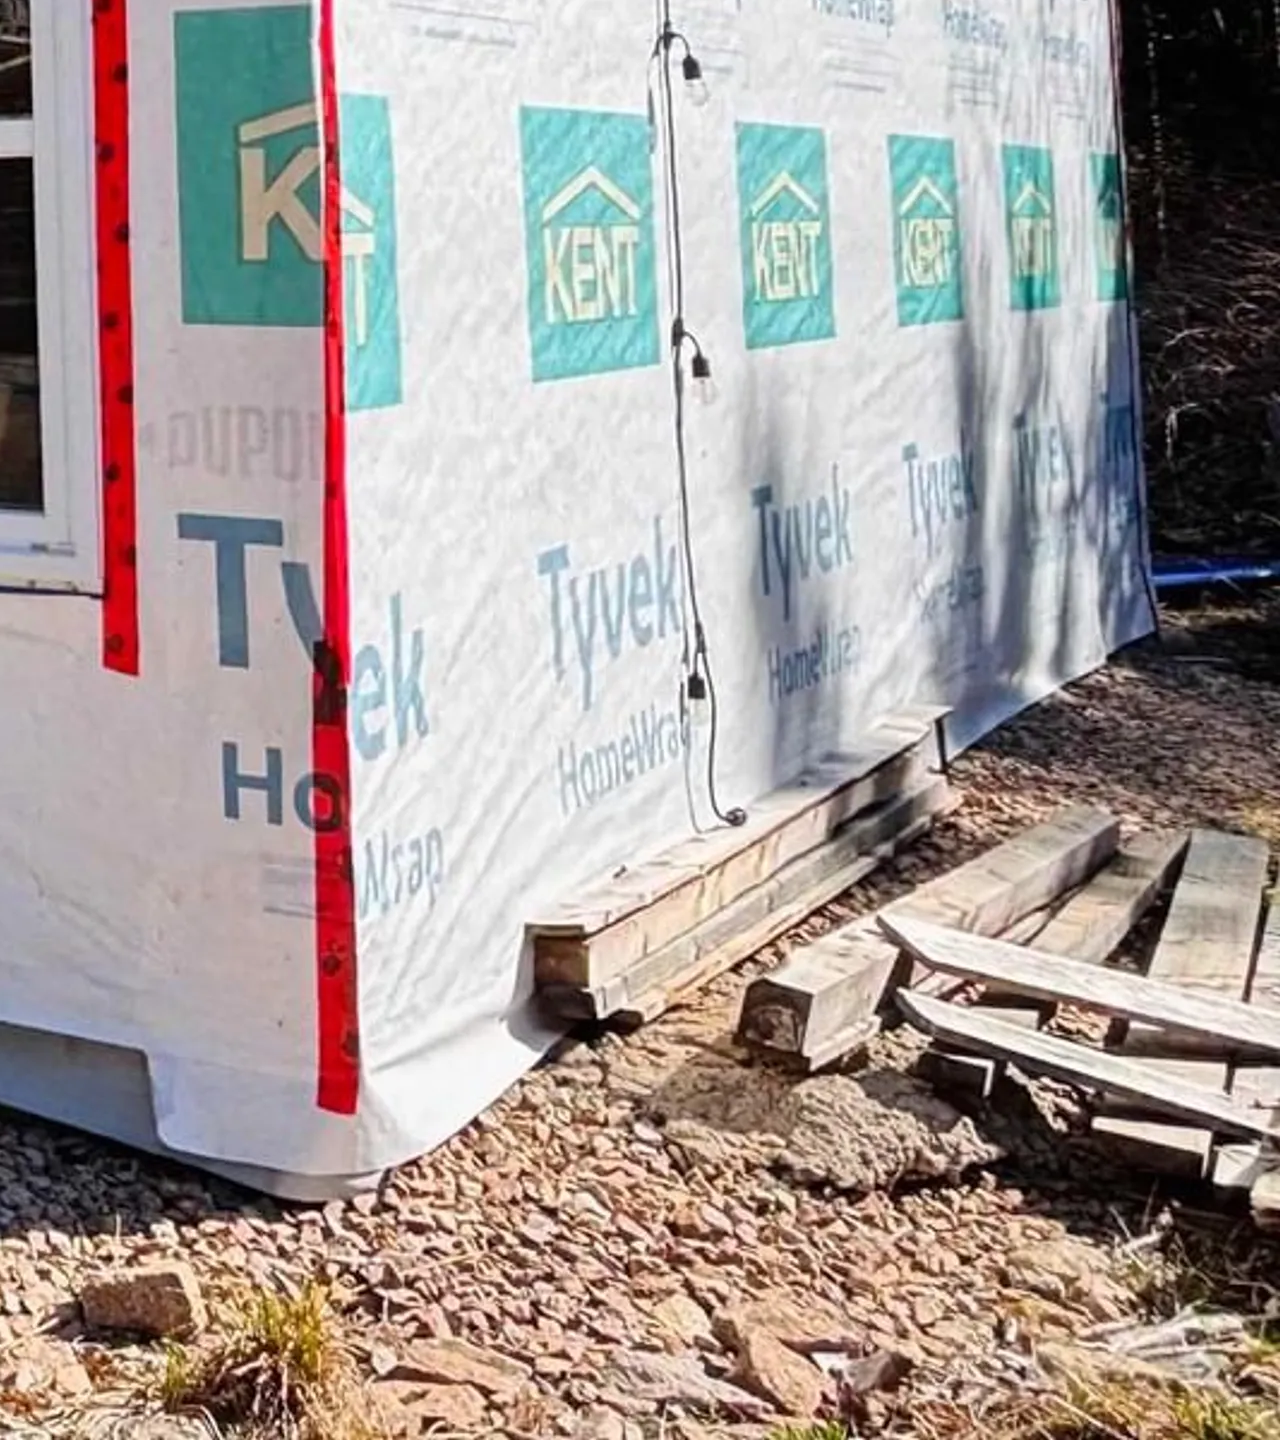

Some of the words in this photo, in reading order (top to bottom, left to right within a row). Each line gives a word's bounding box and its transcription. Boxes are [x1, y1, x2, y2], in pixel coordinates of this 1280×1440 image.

[545, 226, 640, 325] KENT
[750, 220, 820, 301] KENT
[750, 461, 852, 623] Tyvek
[537, 514, 680, 712] Tyvek
